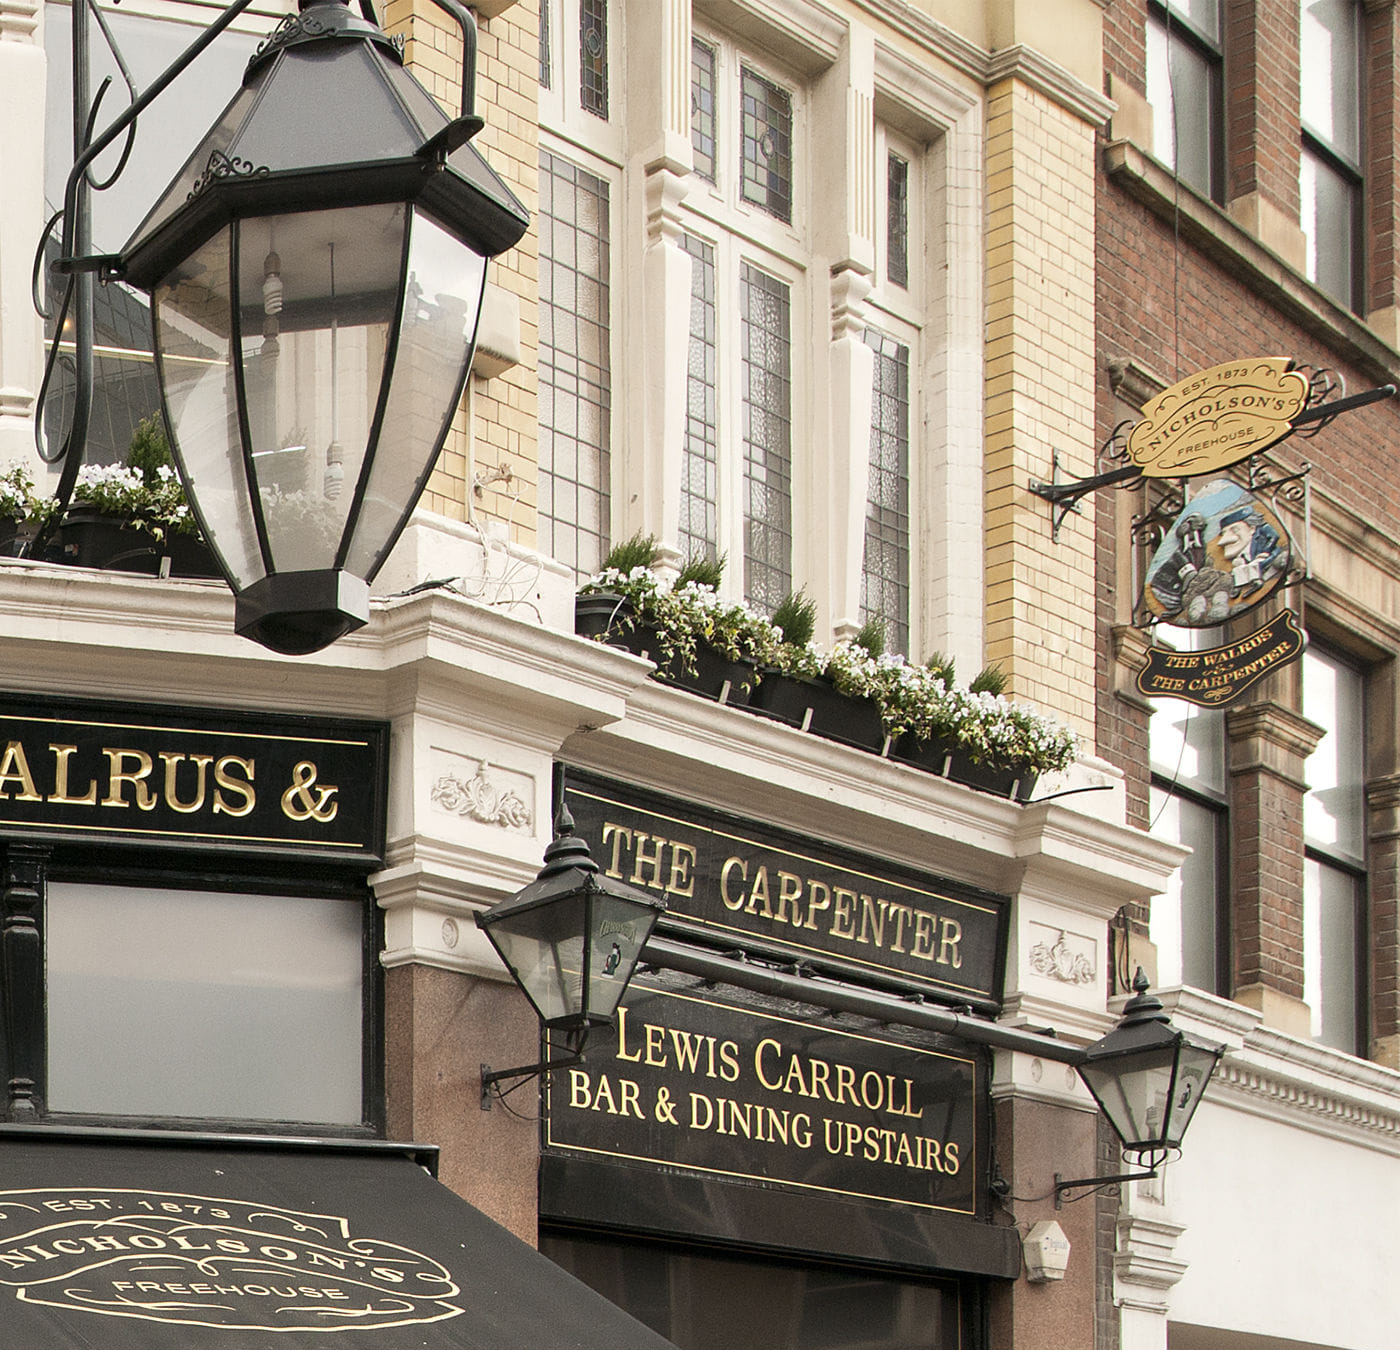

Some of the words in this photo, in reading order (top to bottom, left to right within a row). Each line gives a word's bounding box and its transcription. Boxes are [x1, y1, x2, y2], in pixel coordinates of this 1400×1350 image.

[1181, 378, 1211, 397] EST.
[1217, 366, 1249, 383] 1873
[1150, 394, 1287, 451] NICHOLSON'S
[1176, 425, 1255, 457] FREEHOUSE
[1151, 674, 1186, 692] THE
[1188, 641, 1292, 692] CARPENTER
[1165, 653, 1199, 669] THE
[1203, 628, 1274, 668] WALRUS
[281, 760, 339, 823] &
[602, 821, 697, 899] THE
[720, 856, 963, 969] CARPENTER
[569, 1069, 646, 1120] BAR
[654, 1086, 679, 1126] &
[689, 1092, 814, 1148] DINING
[823, 1118, 960, 1176] UPSTAIRS
[42, 1198, 123, 1213] EST.
[136, 1201, 233, 1219] 1873
[110, 1280, 351, 1301] FREEHOUSE
